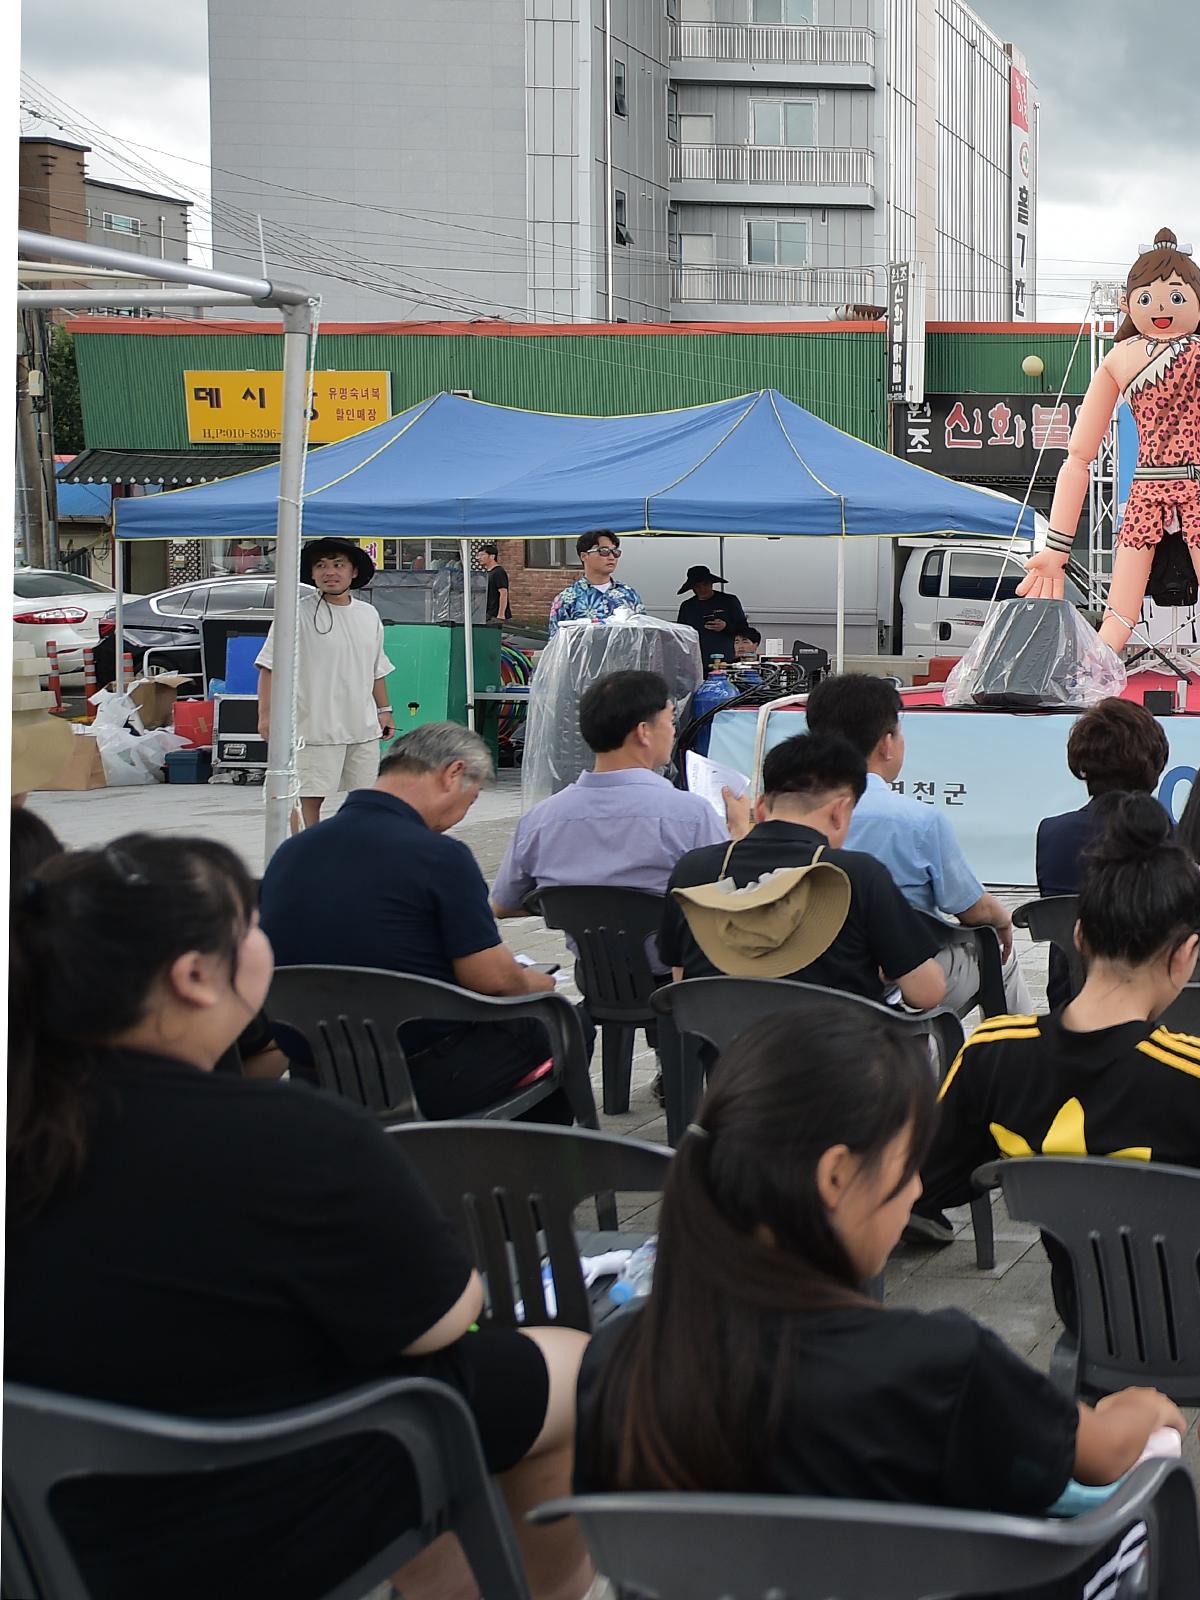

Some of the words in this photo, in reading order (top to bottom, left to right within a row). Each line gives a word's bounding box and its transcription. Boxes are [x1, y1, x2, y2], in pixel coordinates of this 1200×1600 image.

[329, 387, 381, 401] 유명숙녀복
[335, 408, 377, 422] 할인매장
[945, 402, 1112, 449] 신화불
